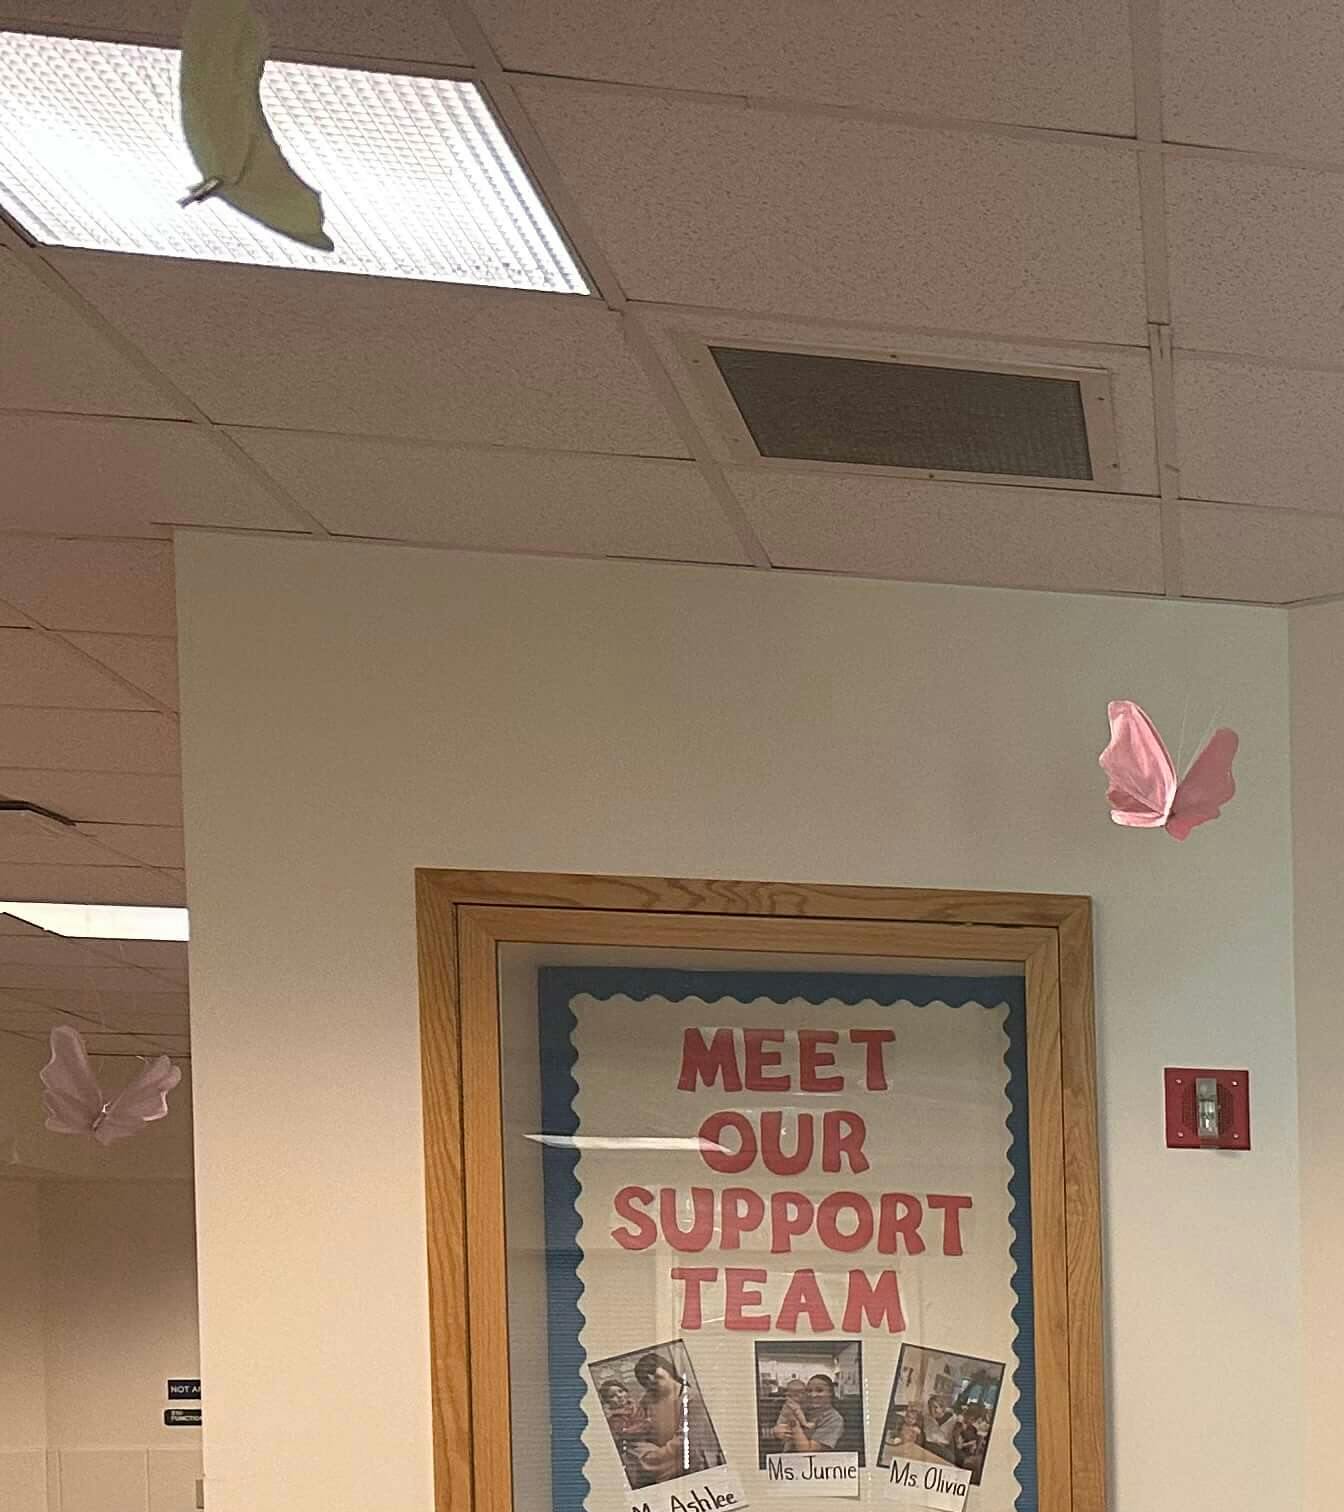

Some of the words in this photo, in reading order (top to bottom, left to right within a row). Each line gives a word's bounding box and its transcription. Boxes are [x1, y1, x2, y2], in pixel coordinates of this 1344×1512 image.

[677, 1027, 896, 1093] MEET
[697, 1110, 870, 1175] OUR
[611, 1186, 973, 1257] SUPPORT
[671, 1267, 906, 1334] TEAM
[171, 1385, 190, 1393] NOT
[768, 1457, 797, 1481] Ms.
[801, 1455, 857, 1482] Jurnie
[890, 1459, 920, 1489] Ms.
[923, 1467, 966, 1497] Olivia
